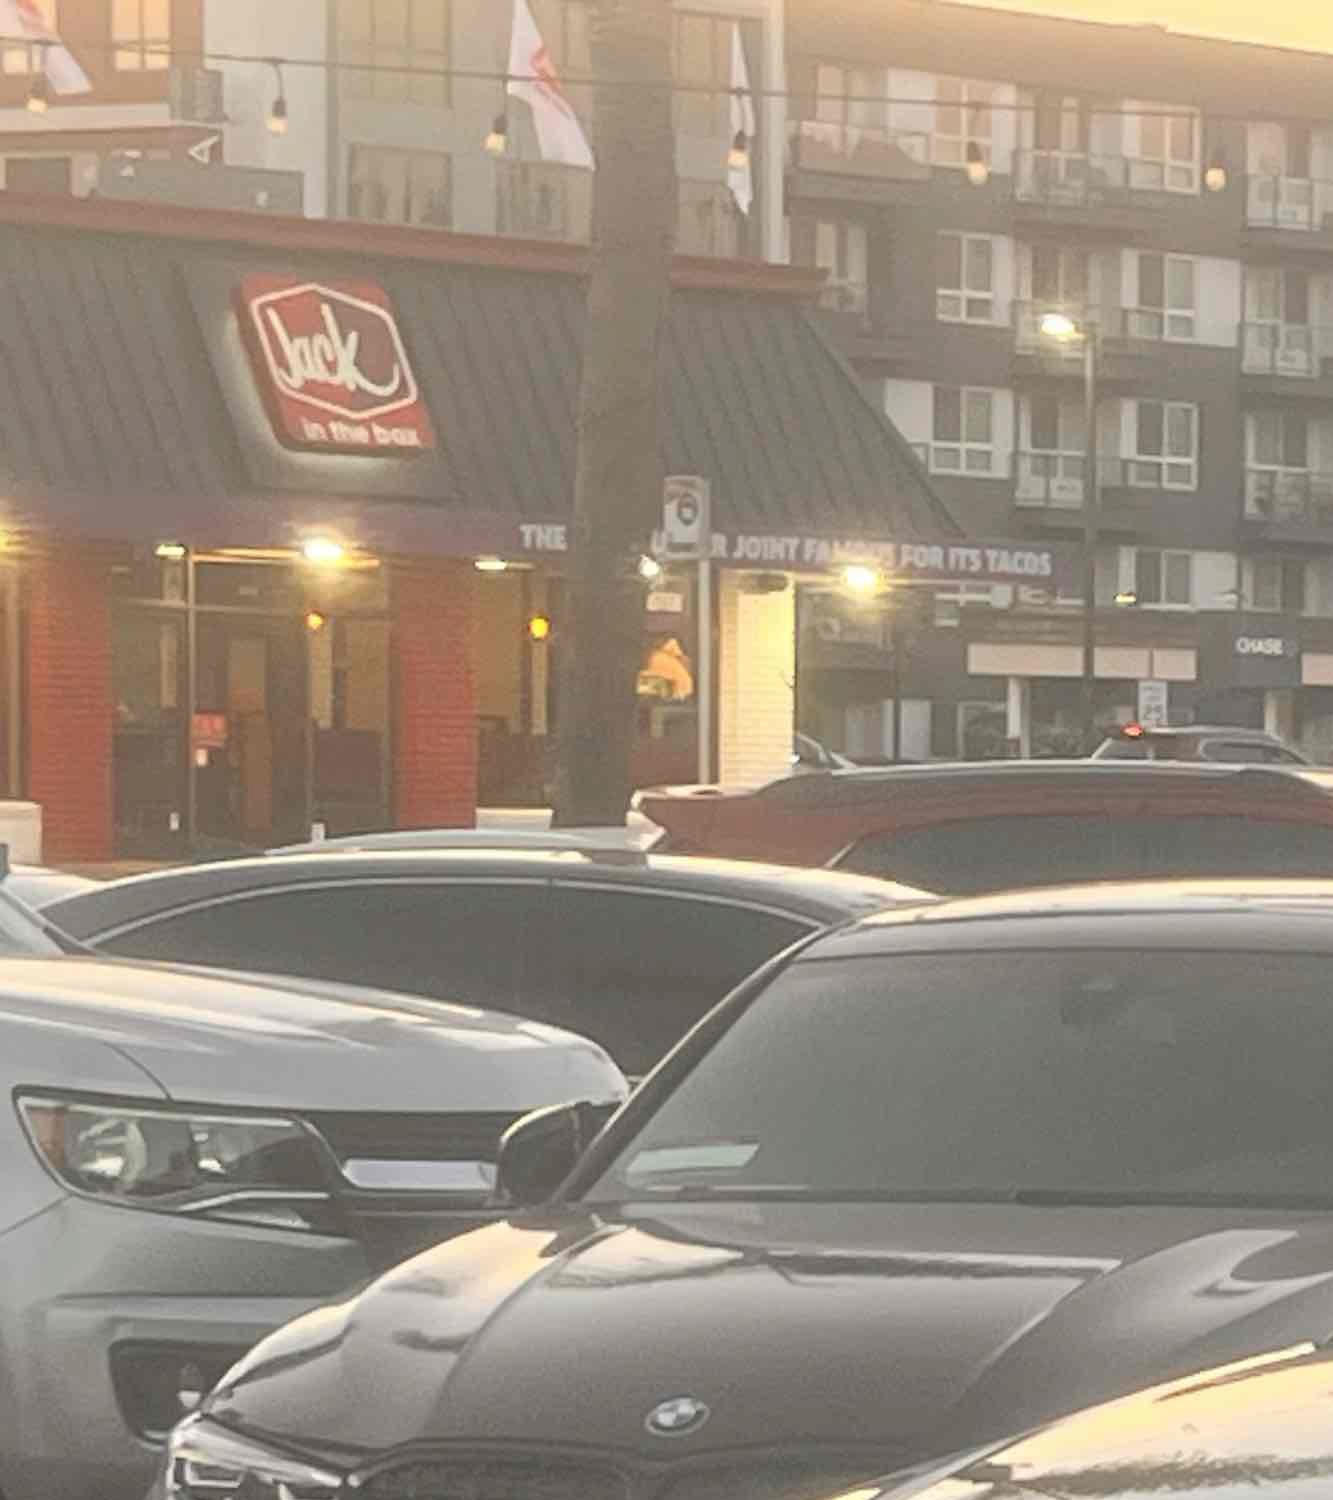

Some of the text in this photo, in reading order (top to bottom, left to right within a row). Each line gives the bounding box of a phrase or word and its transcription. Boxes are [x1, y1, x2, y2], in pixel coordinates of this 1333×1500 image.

[265, 302, 400, 397] Jack
[301, 417, 423, 447] in the box
[519, 523, 568, 552] THE
[733, 535, 800, 561] JOINT
[900, 543, 945, 569] FOR
[948, 547, 982, 573] ITS
[987, 549, 1052, 576] TACOS
[1235, 636, 1284, 656] CHASE
